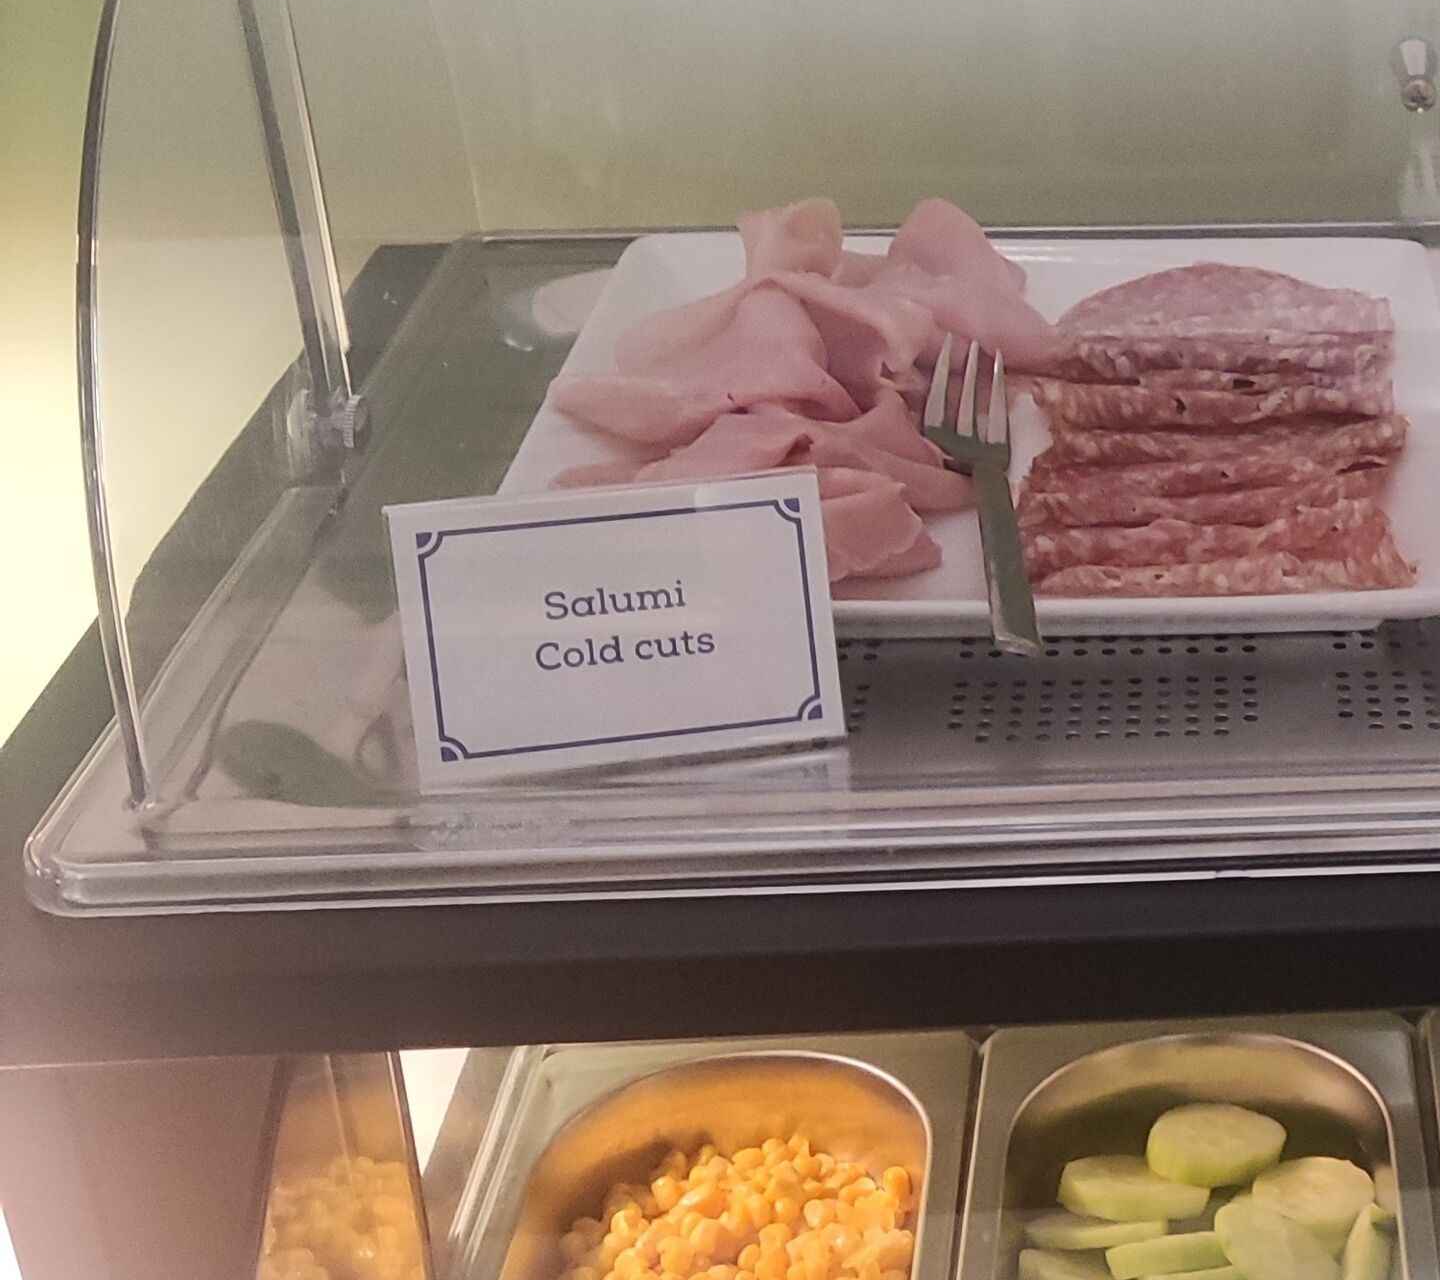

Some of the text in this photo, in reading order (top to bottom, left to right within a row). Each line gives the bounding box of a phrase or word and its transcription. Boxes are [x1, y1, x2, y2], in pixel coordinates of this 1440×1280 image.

[544, 579, 686, 620] Salumi
[535, 630, 715, 670] Cold cuts
